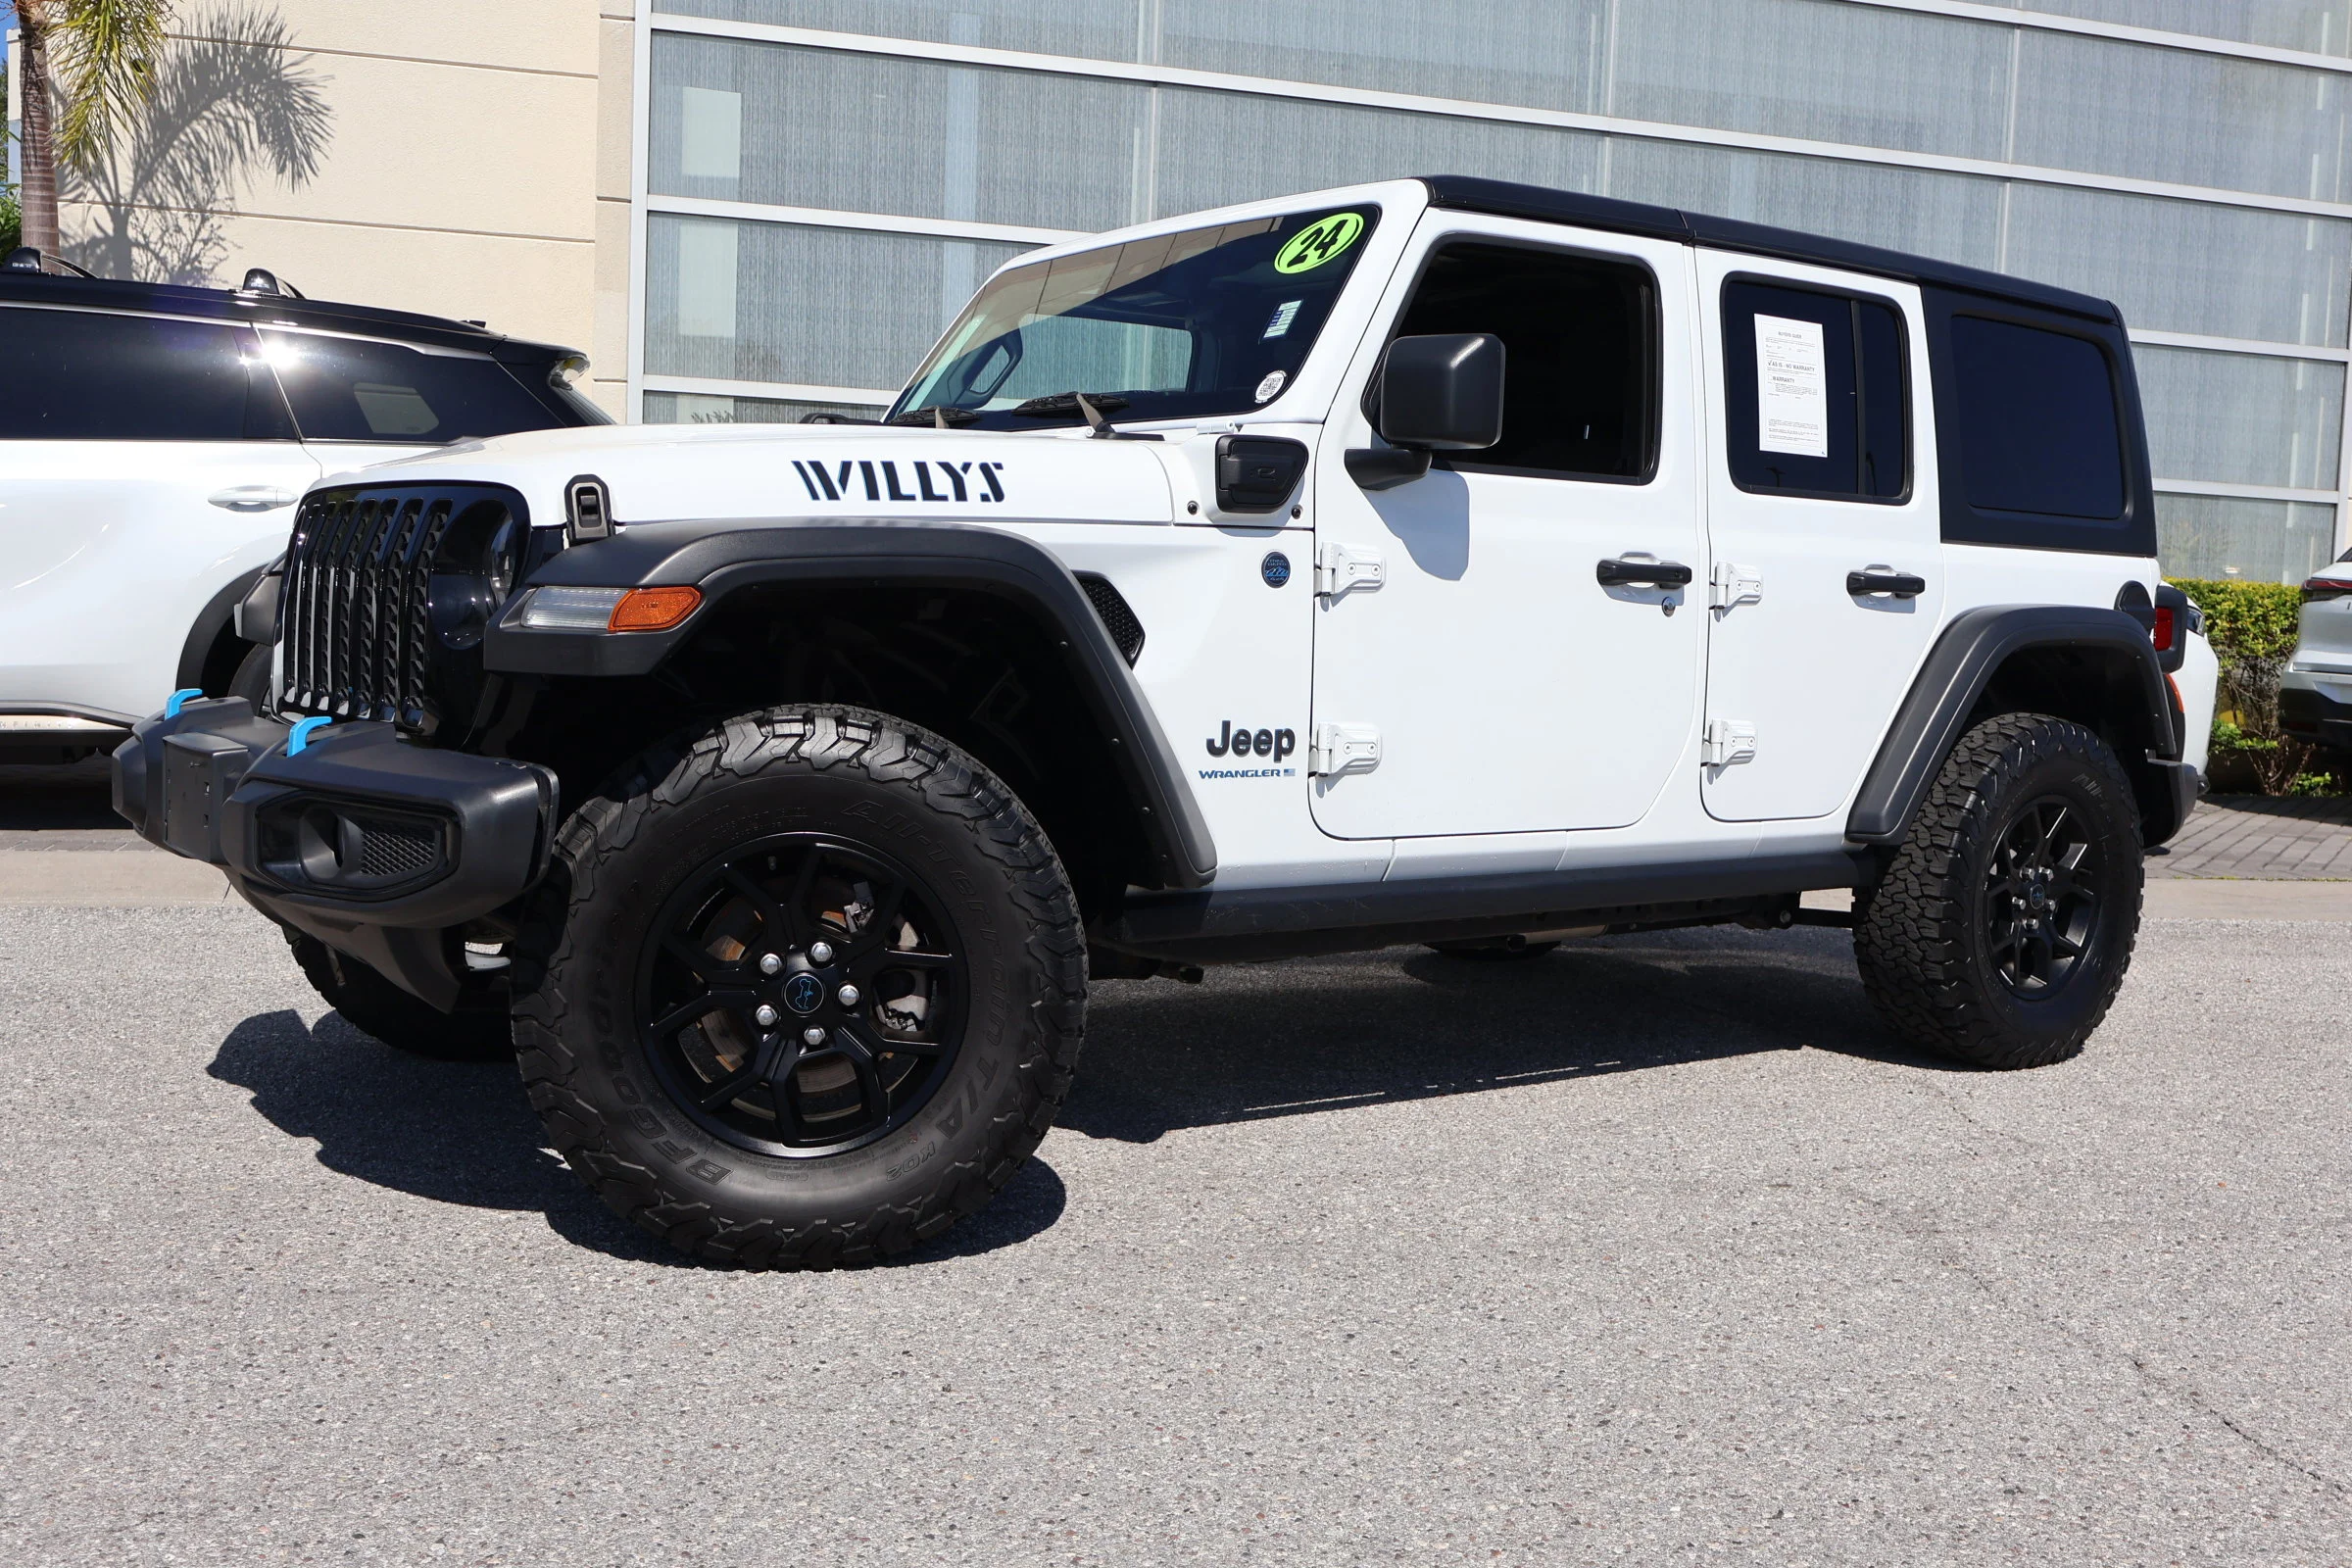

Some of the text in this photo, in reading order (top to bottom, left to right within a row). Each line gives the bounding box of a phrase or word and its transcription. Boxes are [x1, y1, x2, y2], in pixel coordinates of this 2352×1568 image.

[1287, 219, 1348, 269] 24
[791, 461, 1005, 503] WILLYS
[1205, 720, 1296, 763] Jeep
[1199, 768, 1281, 779] WRANGLER
[936, 1056, 1000, 1140] T/A
[886, 1141, 936, 1182] KO2
